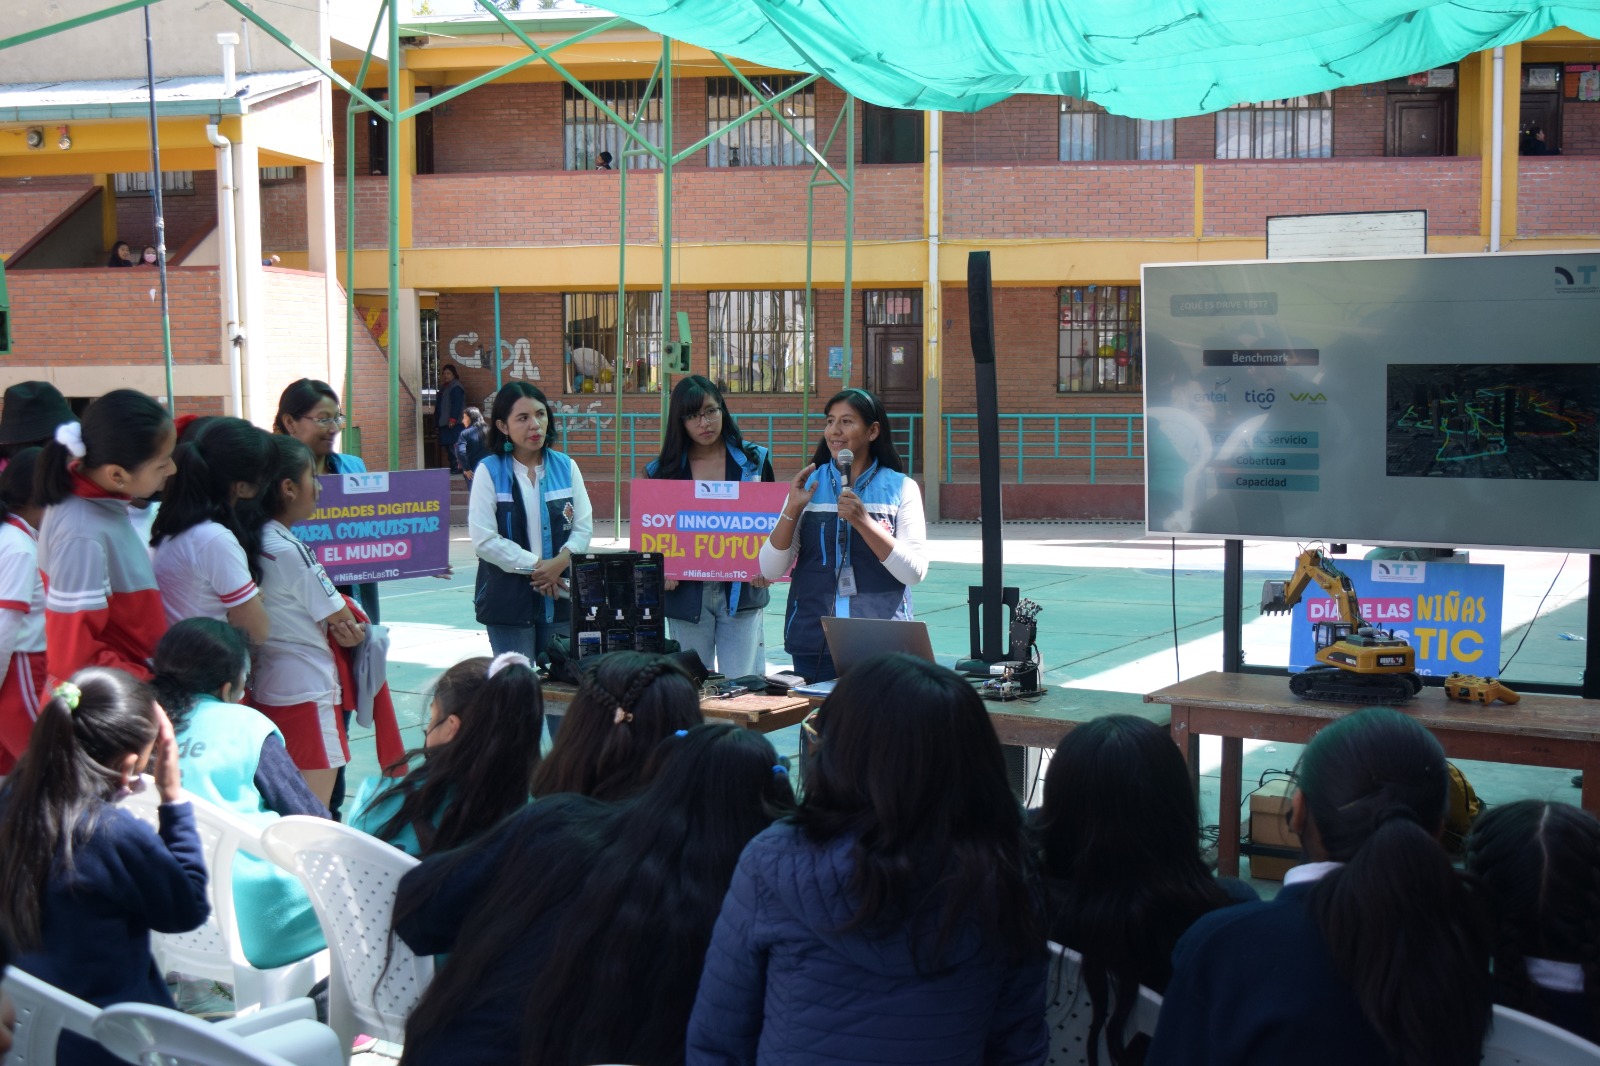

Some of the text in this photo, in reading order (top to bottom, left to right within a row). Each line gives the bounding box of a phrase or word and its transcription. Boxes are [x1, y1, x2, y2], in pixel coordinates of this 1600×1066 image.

[1204, 300, 1215, 310] ES
[1216, 300, 1241, 310] DRIVE
[1242, 299, 1269, 309] TEST?
[1232, 353, 1289, 363] Benchmark
[1268, 434, 1309, 446] Servicio
[1236, 455, 1286, 466] Cobertura
[1235, 477, 1287, 488] Capacidad
[377, 500, 441, 517] DIGITALES
[641, 513, 676, 528] SOY
[290, 515, 441, 542] PARA CONQUISTAR
[323, 541, 408, 563] EL MUNDO
[641, 532, 686, 558] DEL
[333, 568, 400, 583] #NiñasEnLasTIC
[682, 569, 748, 580] #NiñasEnLasTIC
[1377, 603, 1411, 619] LAS
[1417, 591, 1487, 624] NIÑAS
[1413, 627, 1485, 663] TIC
